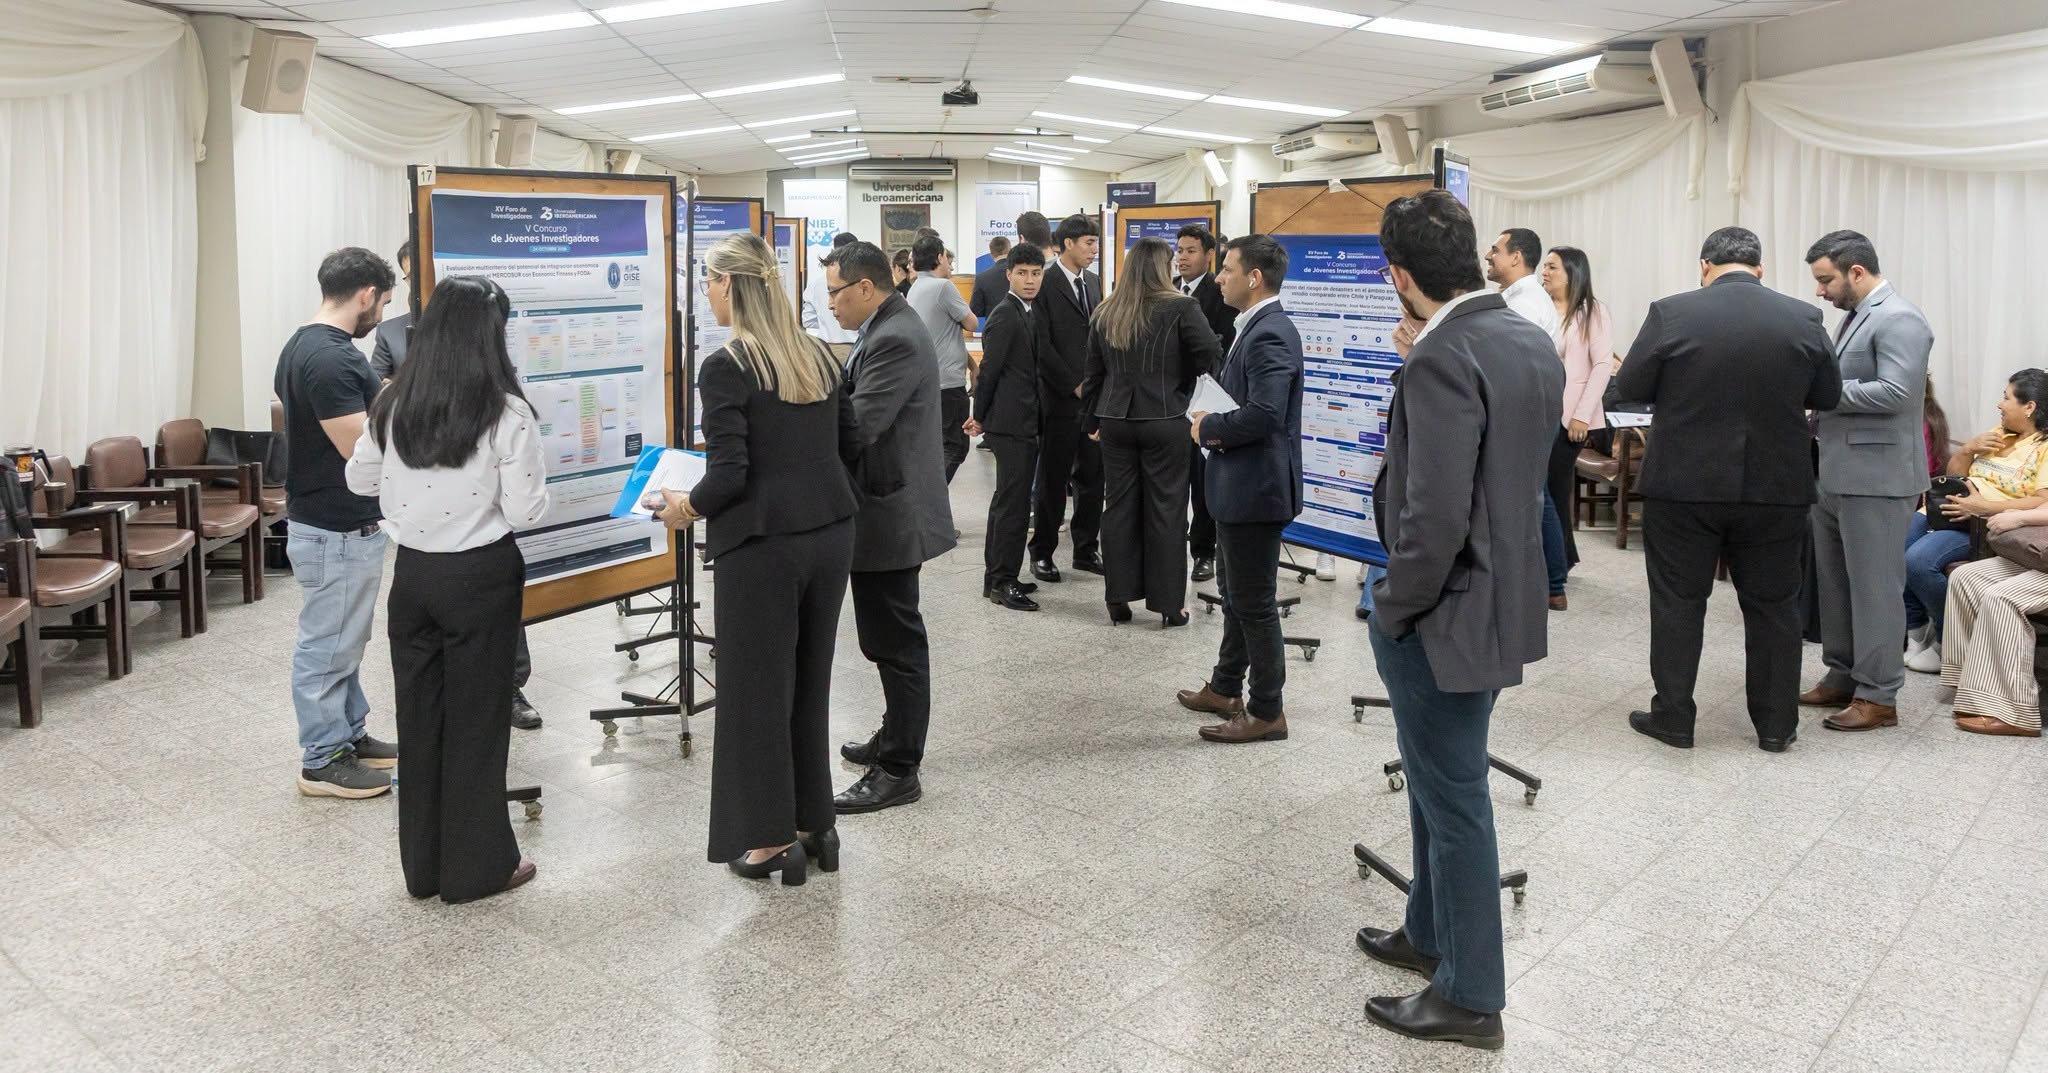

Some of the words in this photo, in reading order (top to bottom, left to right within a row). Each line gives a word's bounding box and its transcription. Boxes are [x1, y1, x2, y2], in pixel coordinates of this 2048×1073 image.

[420, 170, 432, 183] 17
[872, 181, 933, 192] Universidad
[1249, 182, 1257, 191] 15
[862, 192, 943, 203] Iberoamericana
[495, 205, 504, 213] XV
[505, 205, 518, 213] Foro
[490, 212, 533, 221] Investigadores
[808, 219, 835, 228] NIBE
[990, 220, 1013, 229] Foro
[525, 224, 531, 233] V
[533, 224, 568, 233] Concurso
[980, 229, 1017, 238] Investigad
[491, 234, 502, 243] de
[504, 233, 540, 243] Jóvenes
[541, 234, 600, 245] Investigadores
[623, 273, 640, 281] GISE
